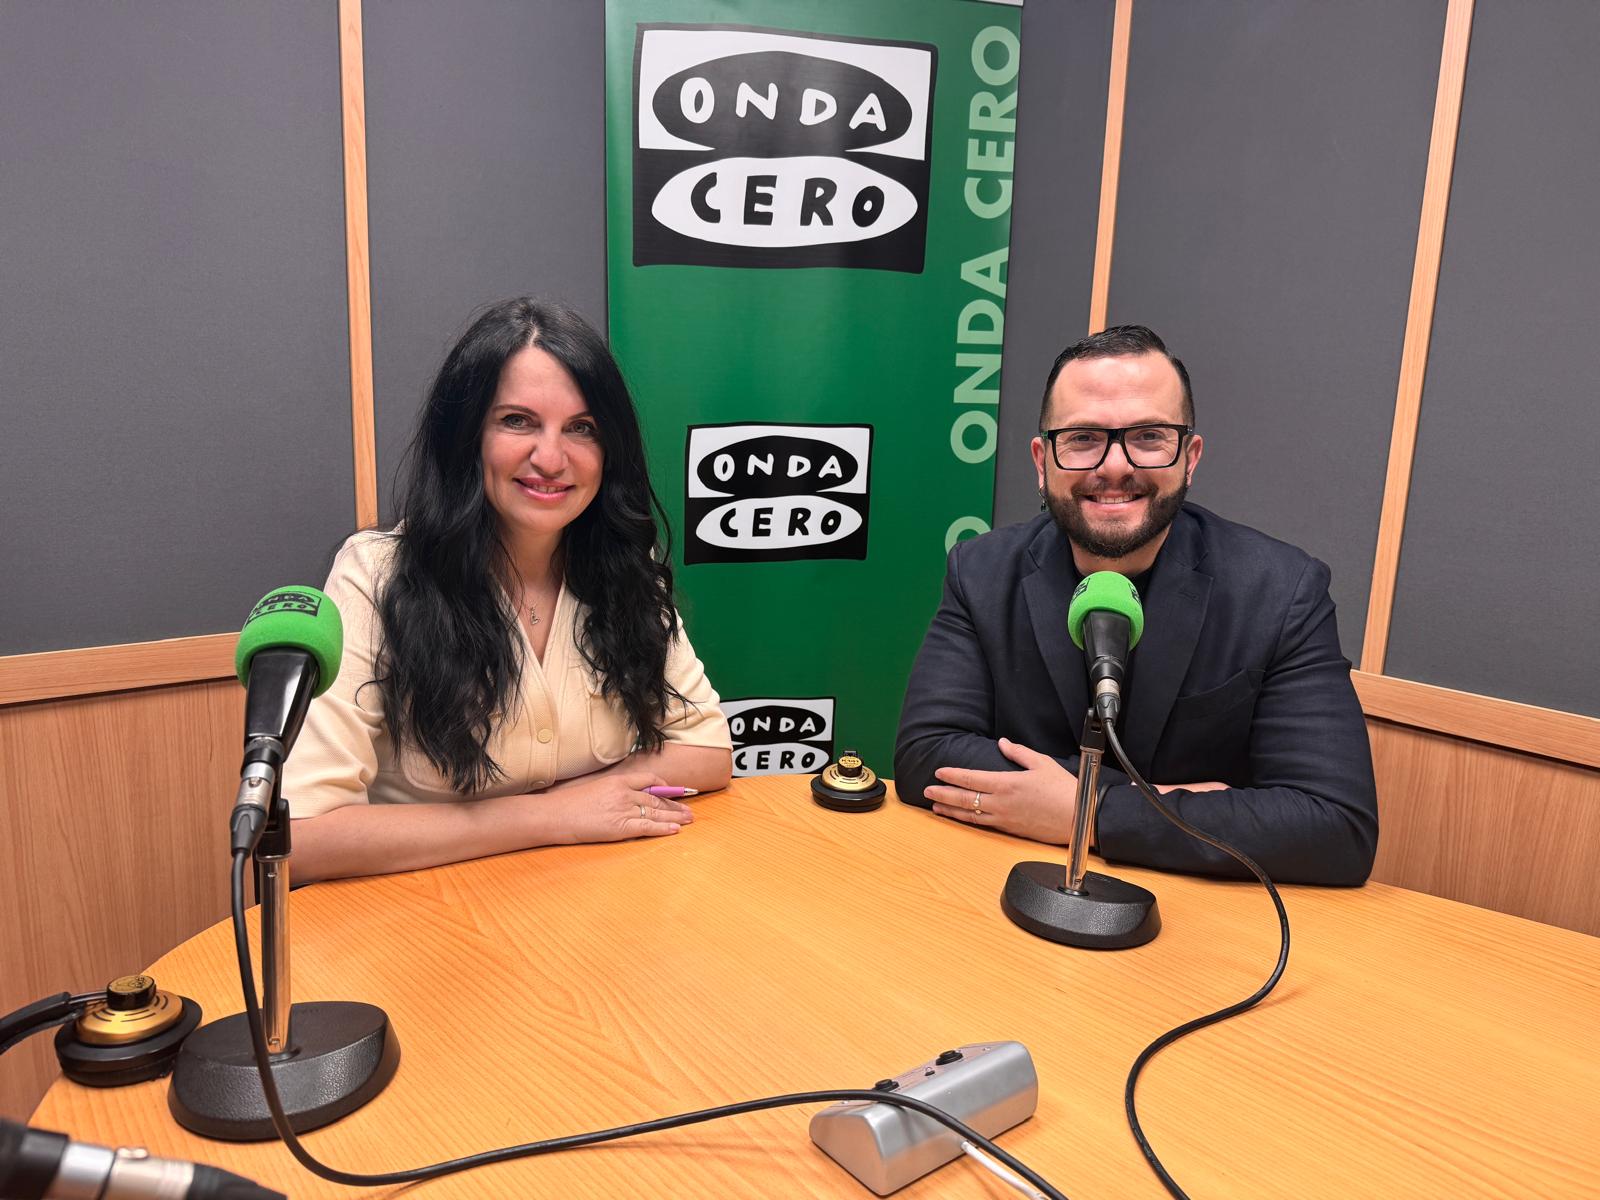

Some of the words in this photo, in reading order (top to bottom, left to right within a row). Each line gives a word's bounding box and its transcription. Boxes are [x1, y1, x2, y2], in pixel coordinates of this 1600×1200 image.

[680, 77, 887, 132] ONDA
[964, 26, 1020, 218] CERO
[691, 172, 885, 228] CERO
[950, 246, 1009, 464] ONDA
[713, 453, 843, 482] ONDA
[720, 507, 842, 538] CERO
[730, 716, 816, 735] ONDA
[735, 750, 816, 770] CERO
